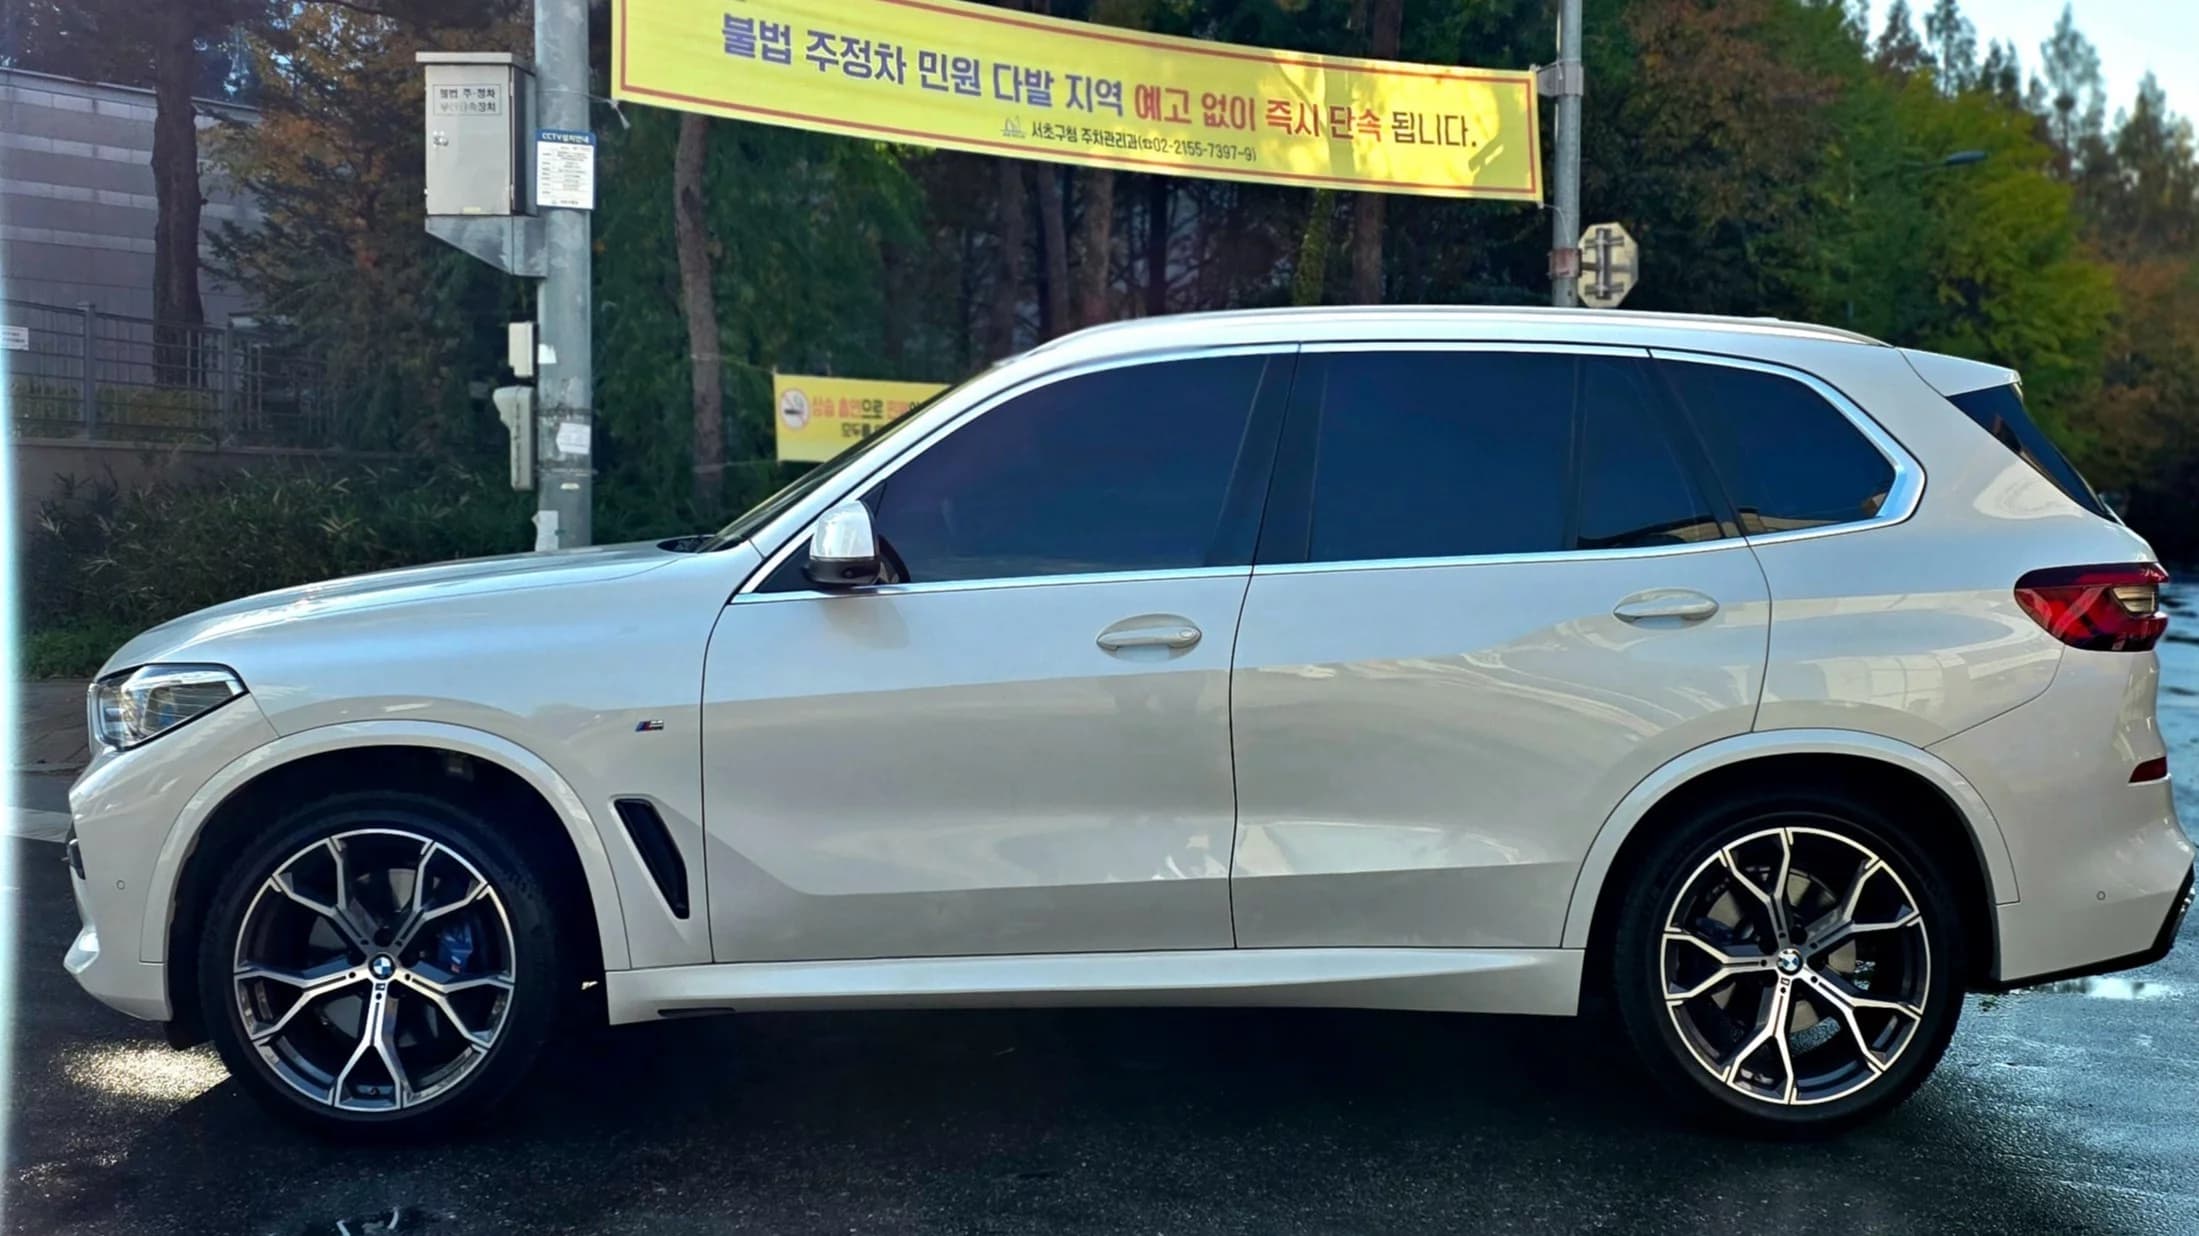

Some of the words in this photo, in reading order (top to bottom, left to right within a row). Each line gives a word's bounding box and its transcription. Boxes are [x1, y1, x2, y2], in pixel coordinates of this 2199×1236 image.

[722, 13, 792, 65] 불법
[805, 29, 907, 85] 주정차
[918, 50, 982, 97] 민원
[993, 62, 1055, 108] 다발
[1065, 74, 1123, 117] 지역
[1135, 84, 1192, 124] 예고
[1202, 92, 1256, 132] 없이
[1265, 99, 1320, 137] 즉시
[1330, 105, 1382, 142] 단속
[1391, 111, 1478, 148] 됩니다.
[1031, 121, 1078, 143] 서초구청
